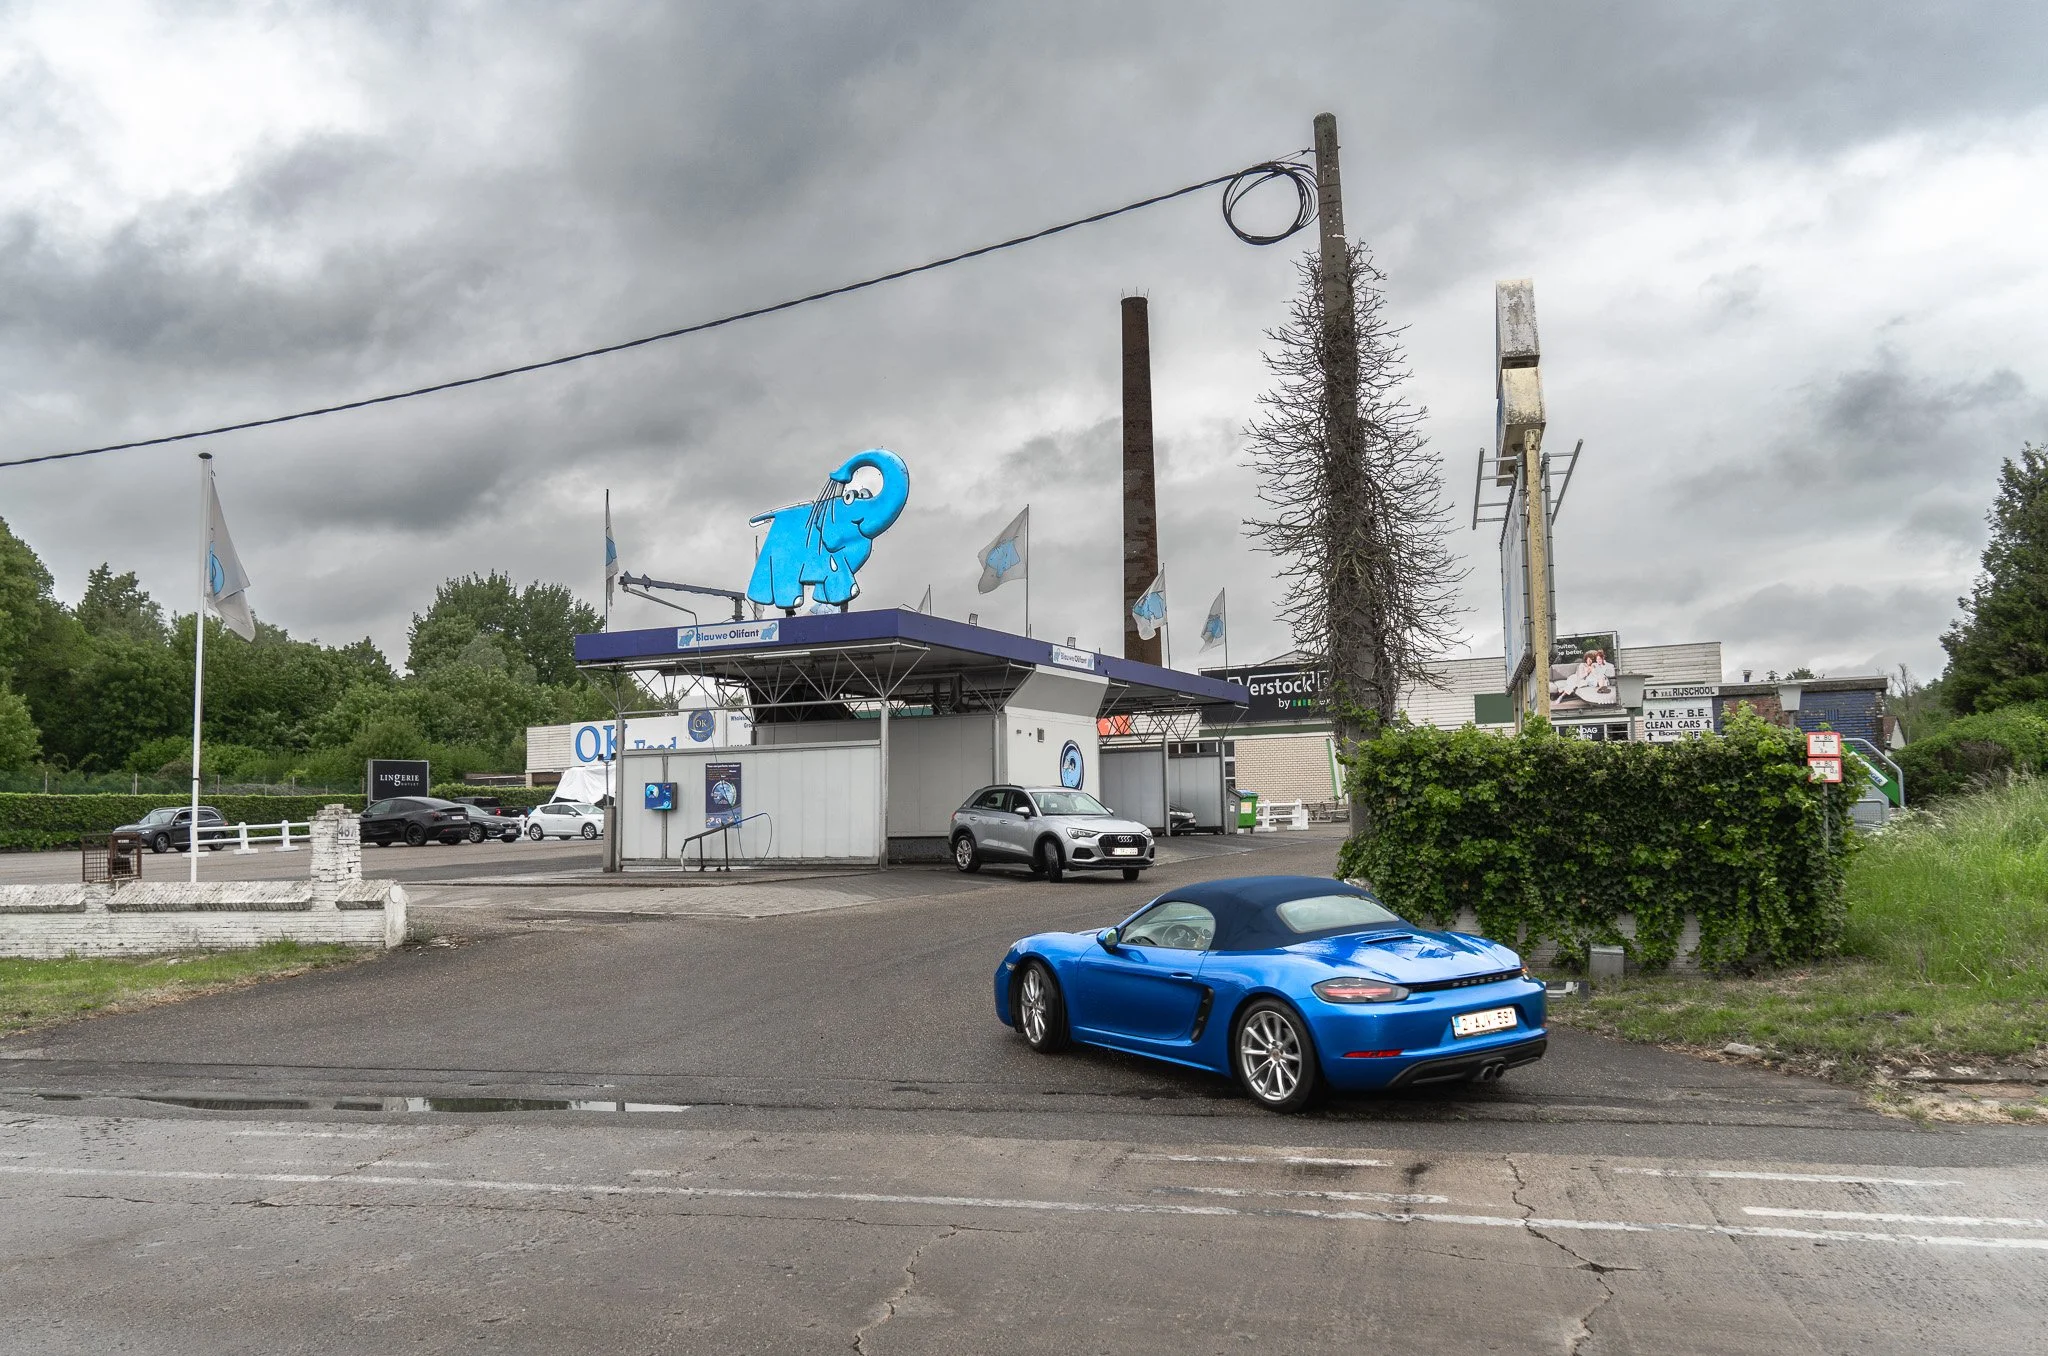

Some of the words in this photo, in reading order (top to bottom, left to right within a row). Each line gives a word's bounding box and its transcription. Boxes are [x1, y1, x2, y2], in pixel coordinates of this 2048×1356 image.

[696, 632, 728, 642] Blauwe
[729, 629, 759, 639] Olifant
[1672, 686, 1715, 697] RIJSCHOOL
[1278, 698, 1290, 710] by
[1687, 708, 1708, 718] B.E.
[1645, 720, 1673, 730] CLEAN
[1677, 720, 1701, 729] CARS
[1452, 975, 1507, 987] PORSCHE
